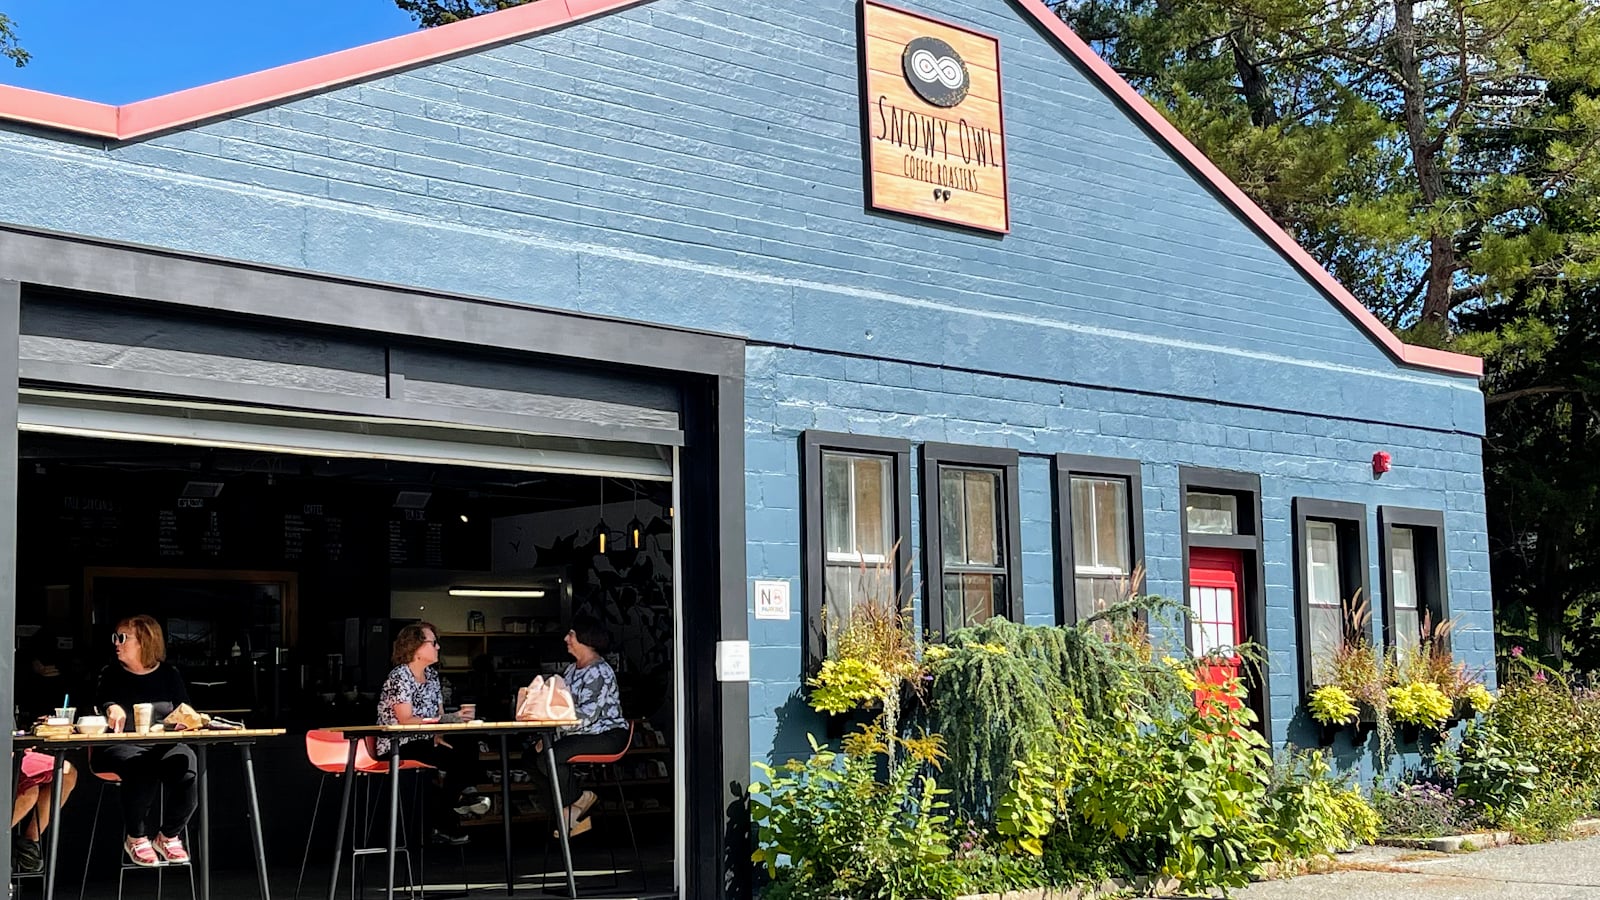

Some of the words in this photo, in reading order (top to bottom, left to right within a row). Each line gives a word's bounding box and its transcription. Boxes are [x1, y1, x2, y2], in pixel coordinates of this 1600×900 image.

[876, 95, 948, 160] SNOWY
[959, 118, 999, 167] OWL
[903, 154, 933, 184] COFFEE
[937, 164, 978, 192] ROASTERS
